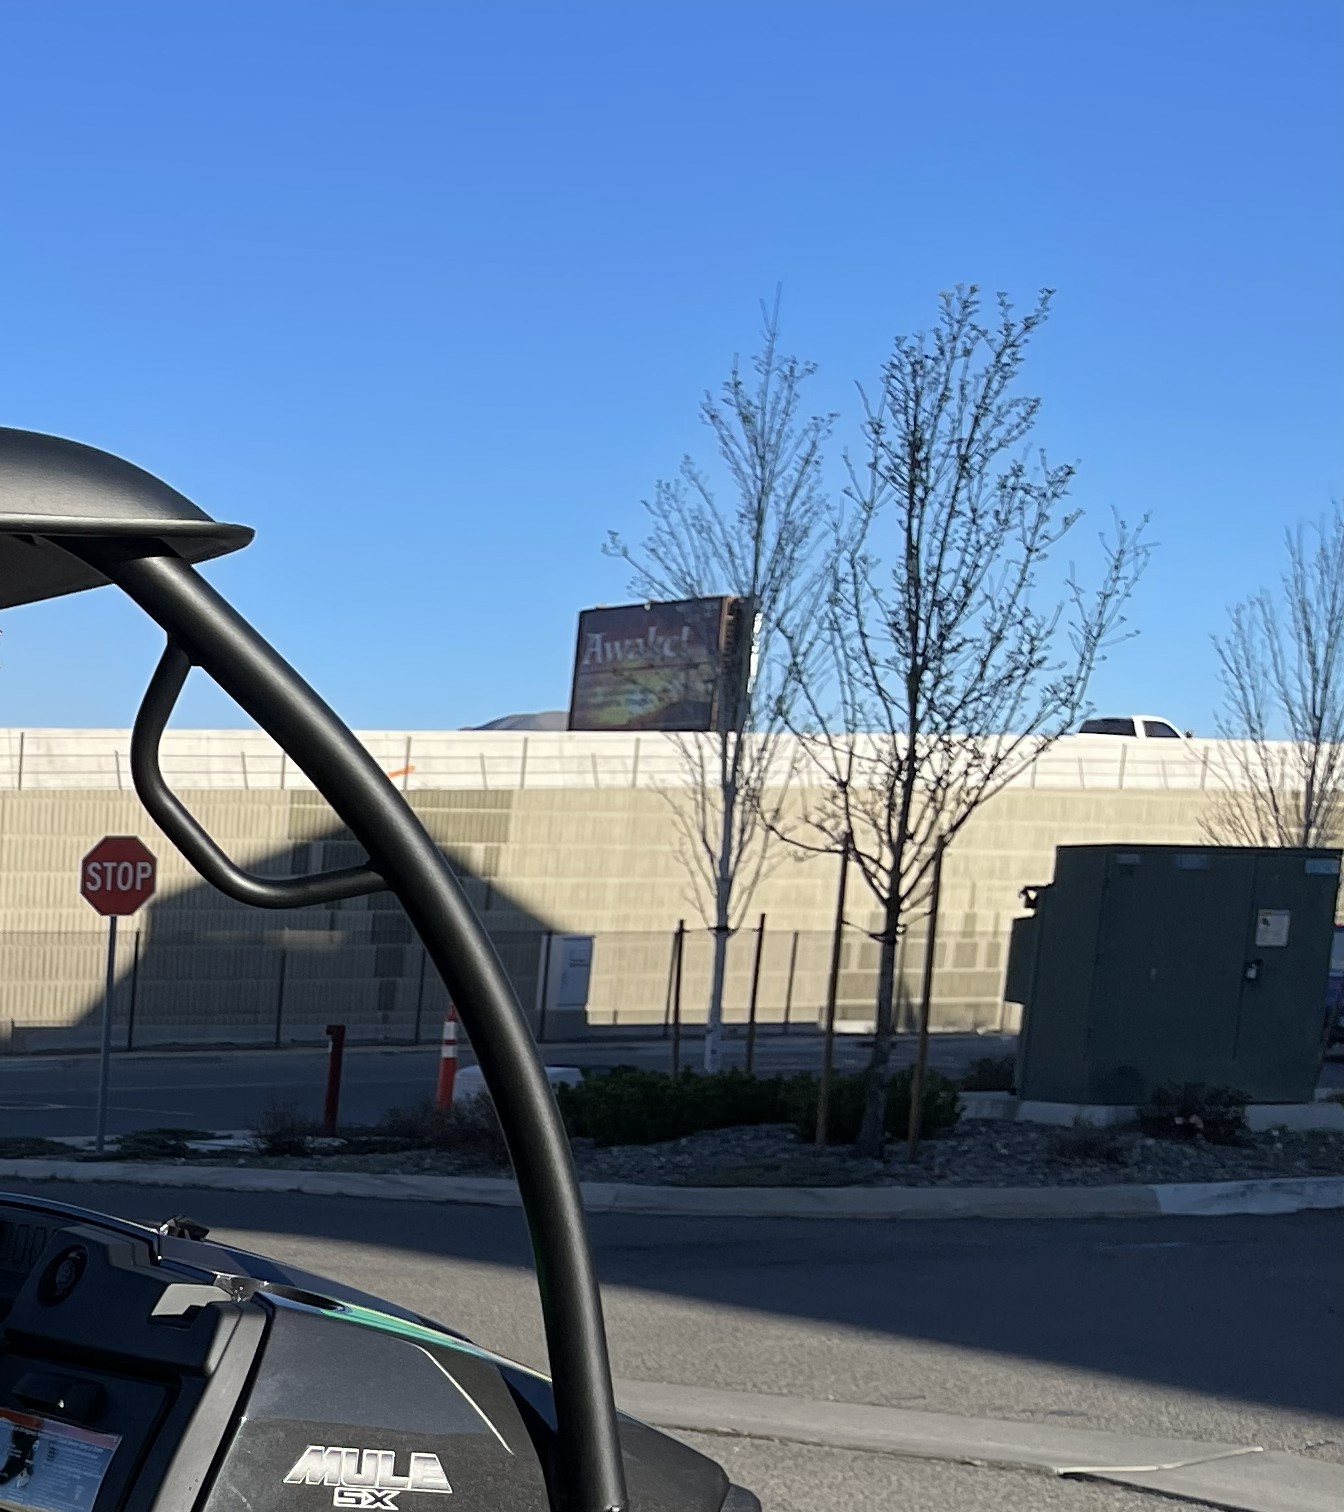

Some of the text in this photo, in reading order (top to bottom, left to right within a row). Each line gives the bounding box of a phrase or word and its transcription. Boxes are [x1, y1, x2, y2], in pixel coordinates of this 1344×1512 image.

[581, 625, 691, 667] Awake!
[85, 861, 153, 892] STOP
[282, 1444, 453, 1494] MULE
[333, 1486, 401, 1511] SX
